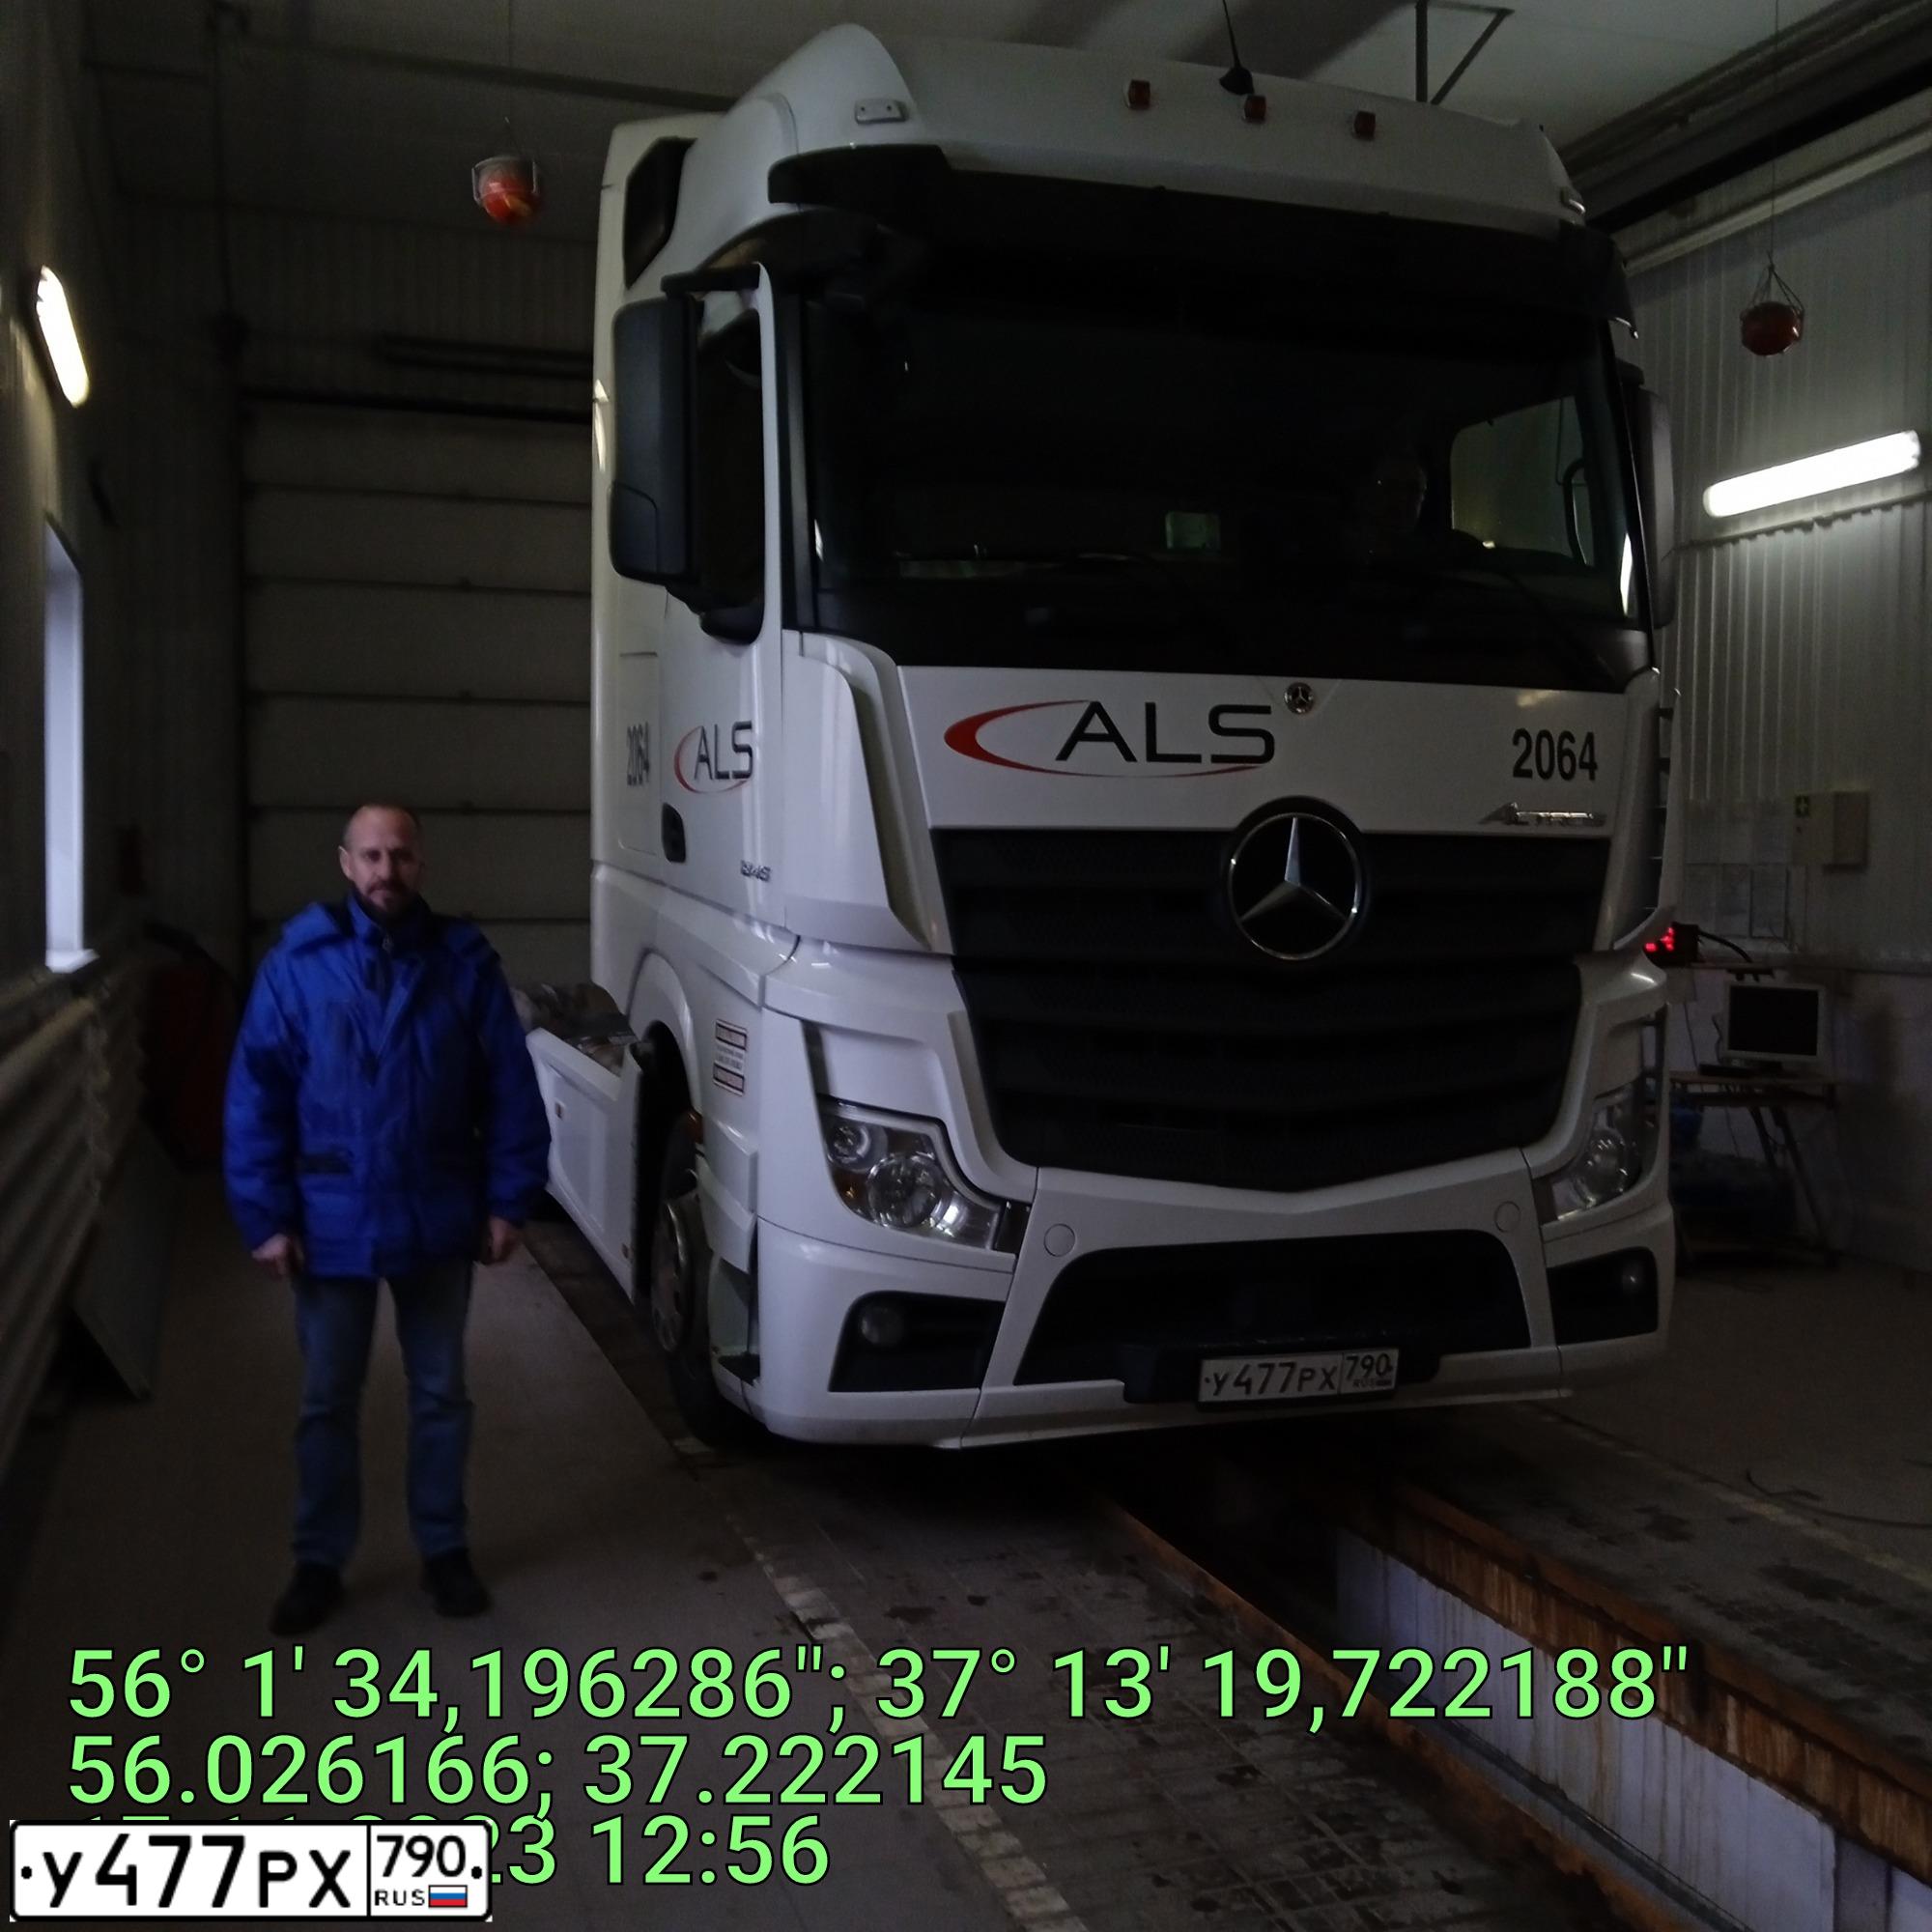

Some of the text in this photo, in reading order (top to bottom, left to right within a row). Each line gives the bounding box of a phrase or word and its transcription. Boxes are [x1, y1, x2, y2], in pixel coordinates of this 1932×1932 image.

[694, 721, 753, 781] ALS
[1055, 699, 1275, 764] ALS
[1512, 727, 1598, 781] 2064
[1346, 1353, 1392, 1380] 790
